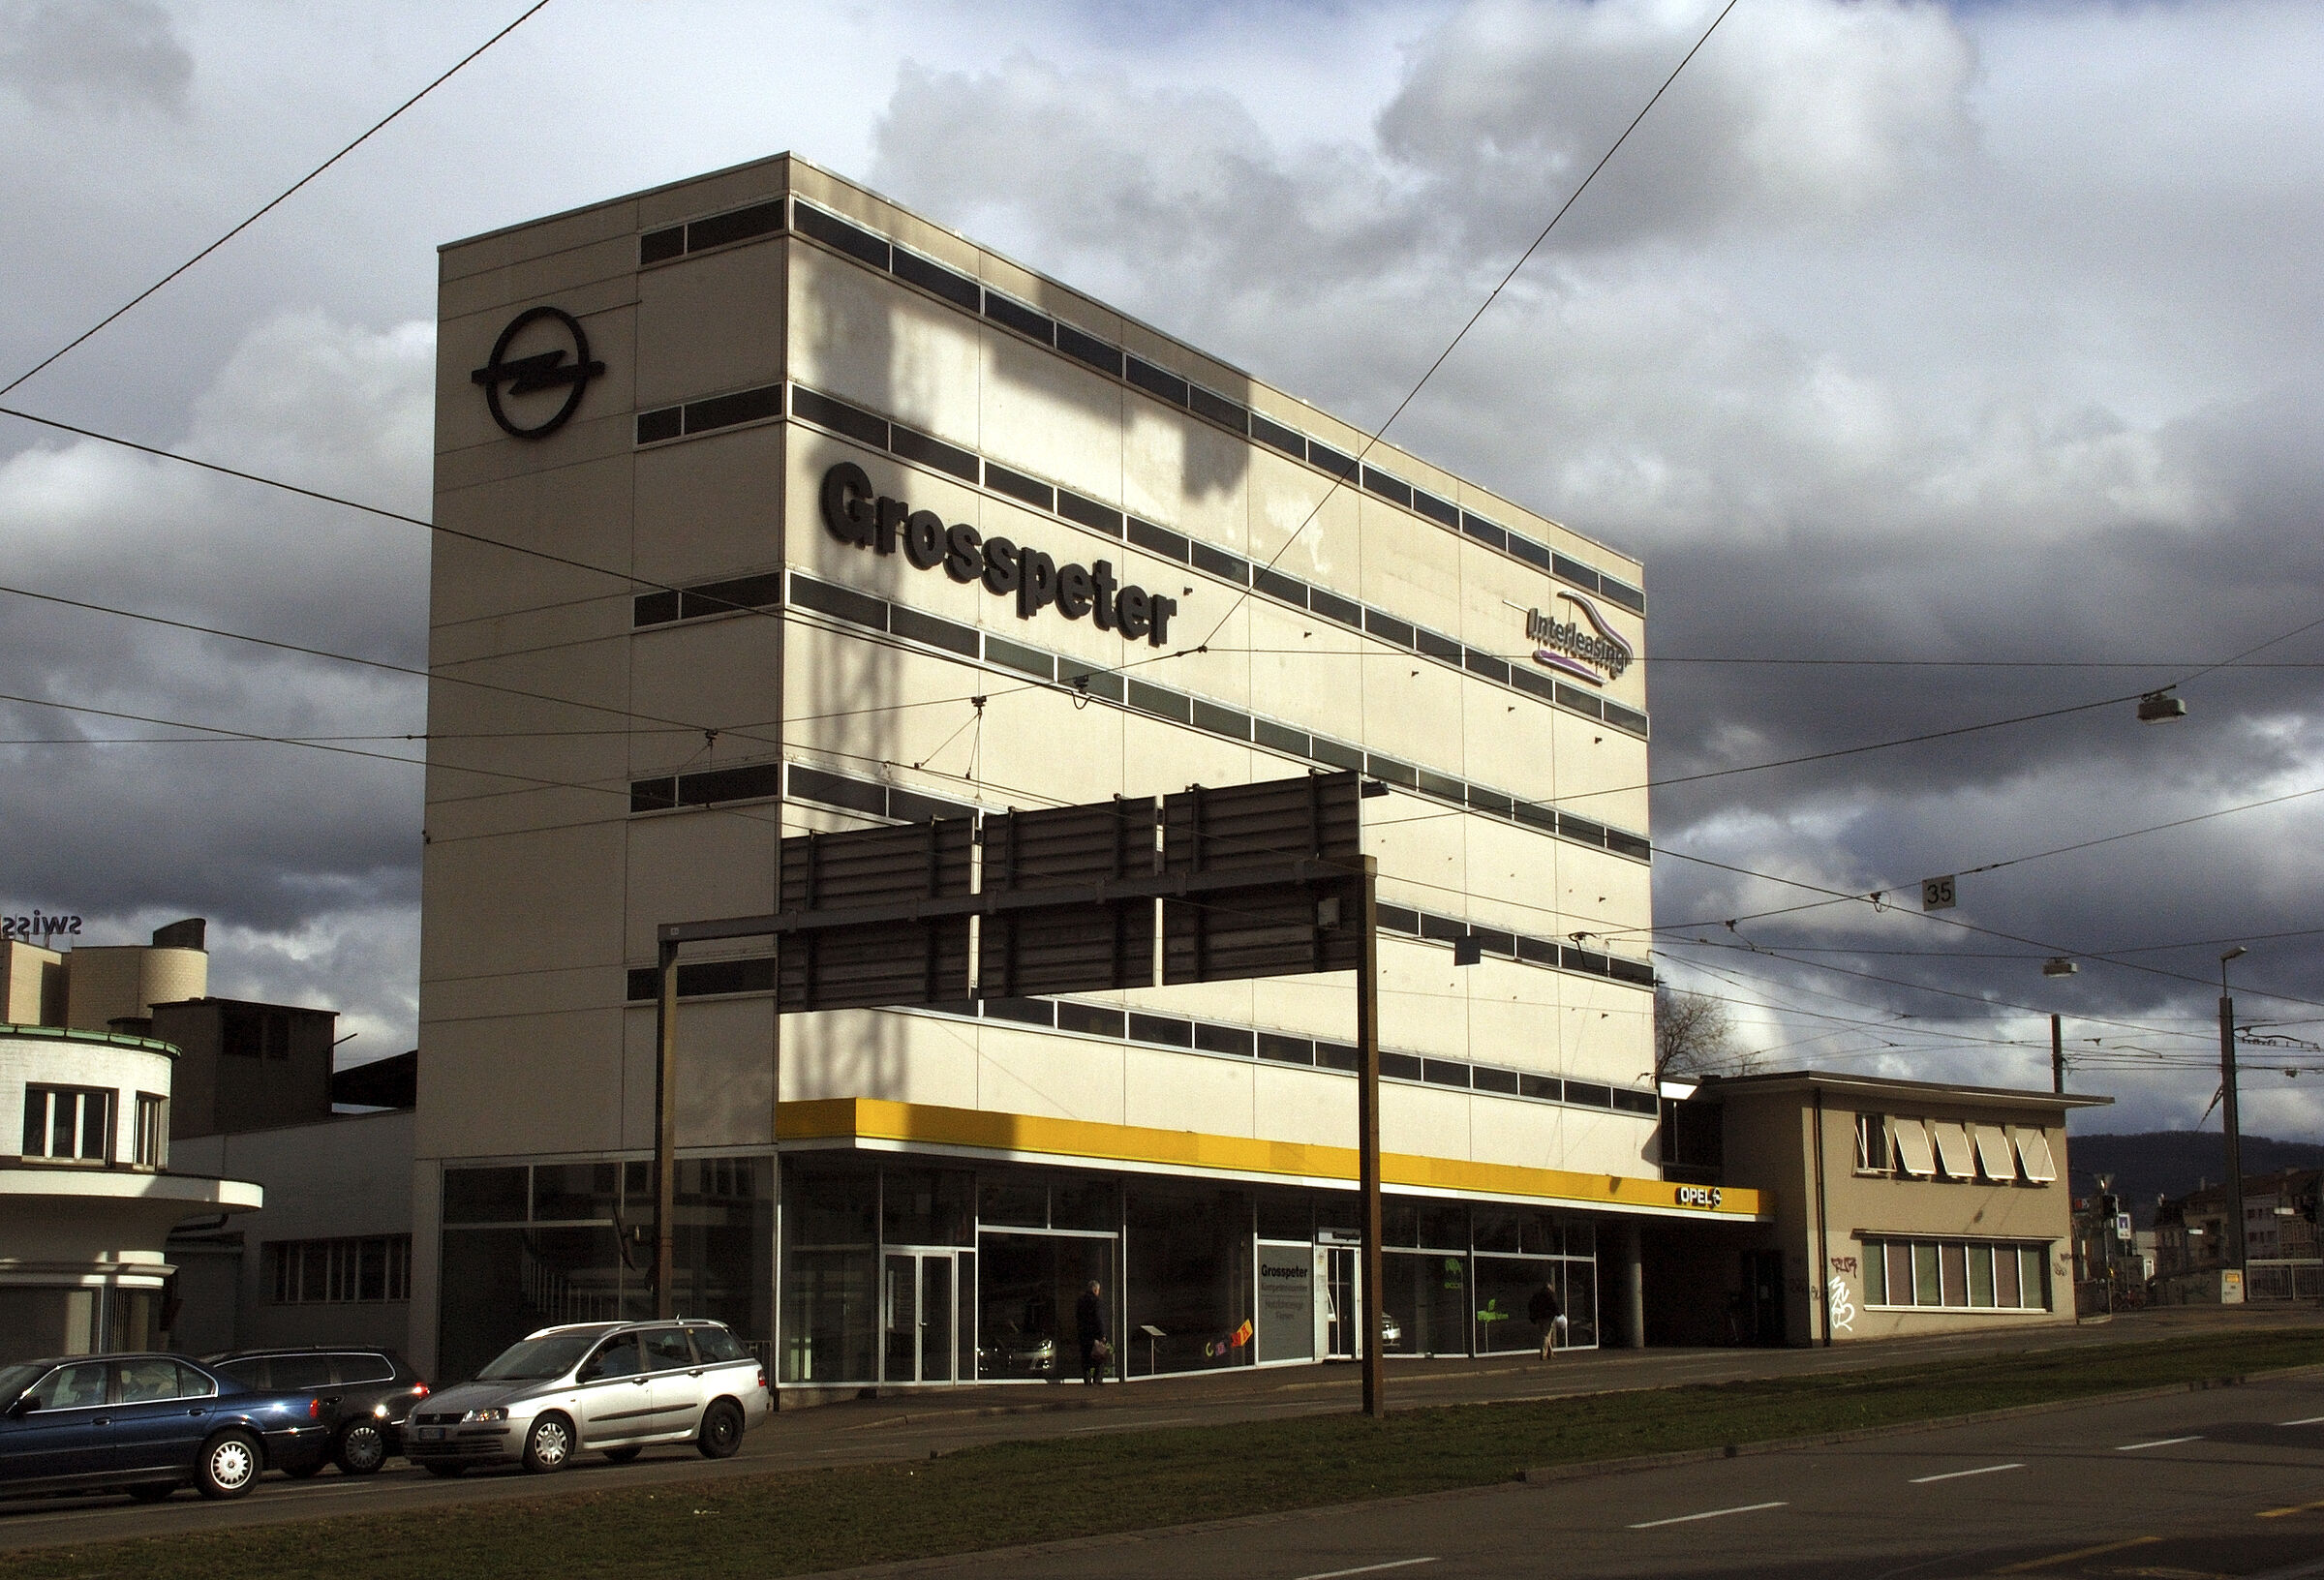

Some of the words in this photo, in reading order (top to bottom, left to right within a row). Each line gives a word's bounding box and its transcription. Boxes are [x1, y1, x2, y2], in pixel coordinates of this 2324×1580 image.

[822, 462, 1177, 647] Grosspeter
[1526, 607, 1629, 680] Interleasing
[1927, 882, 1951, 903] 35
[1681, 1187, 1713, 1204] OPEL
[1261, 1263, 1308, 1279] Grosspeter
